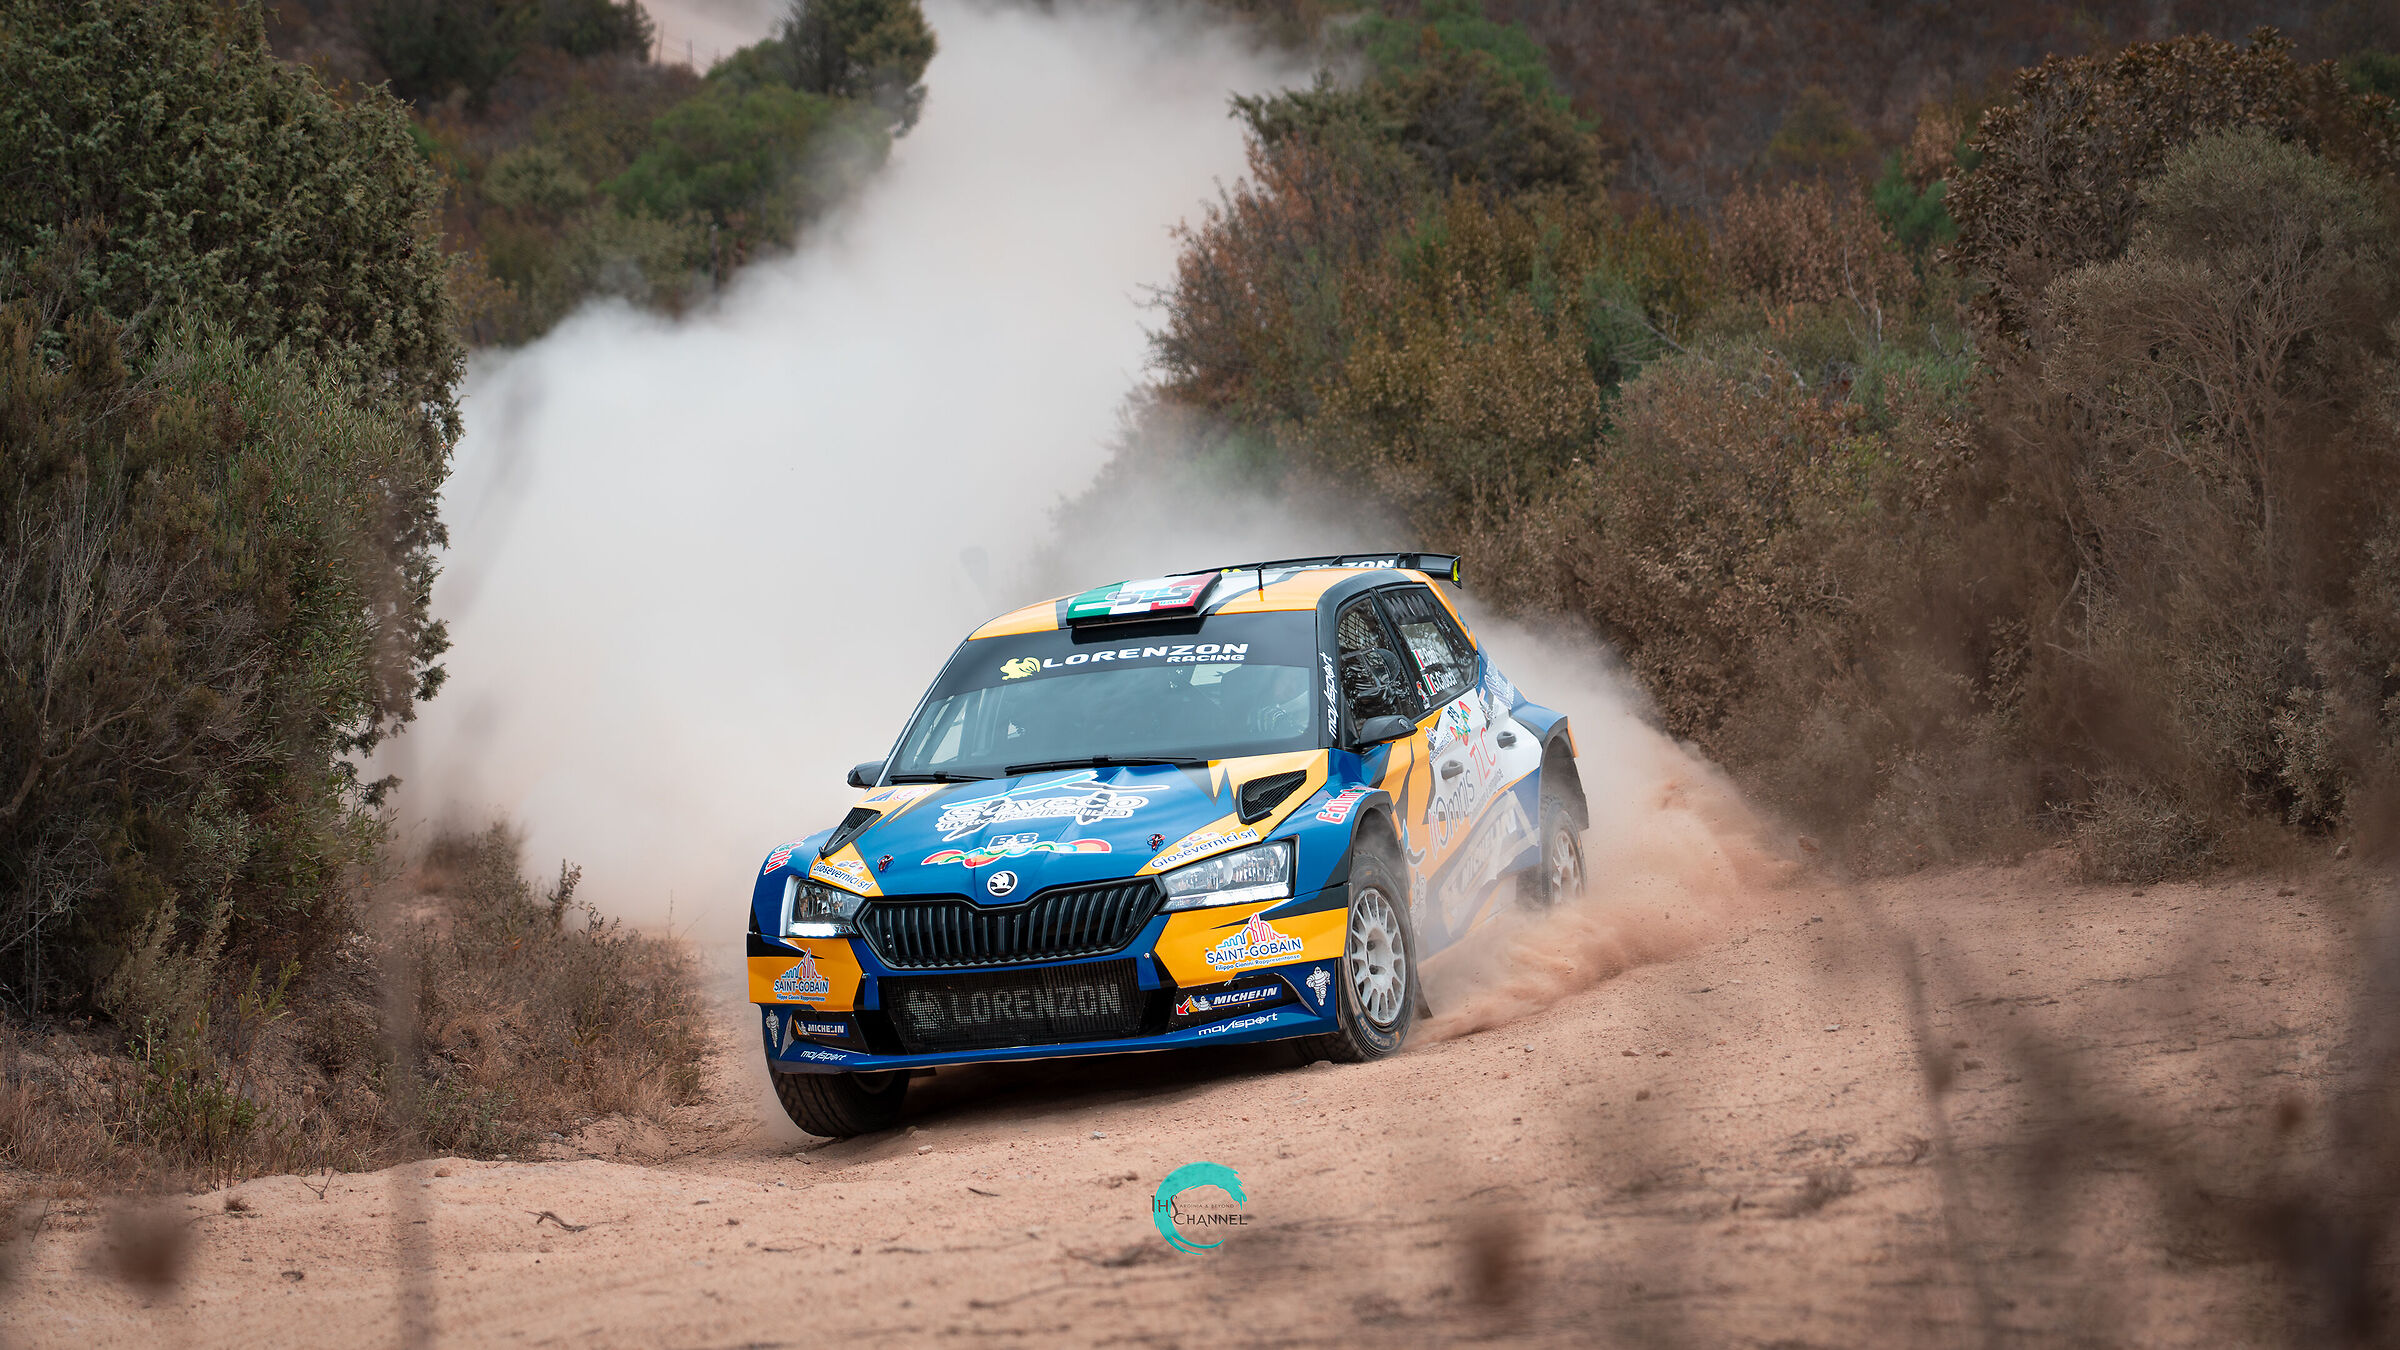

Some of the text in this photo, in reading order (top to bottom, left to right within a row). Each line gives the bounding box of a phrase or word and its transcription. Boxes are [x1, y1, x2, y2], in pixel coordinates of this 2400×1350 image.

[1042, 643, 1249, 669] LORENZON
[1165, 654, 1246, 664] RACING
[1206, 938, 1302, 964] SAINT-GOBAIN
[773, 979, 830, 993] SAINT-GOBAIN
[1212, 986, 1278, 1005] MICHELIN
[950, 983, 1122, 1025] LORENZON
[807, 1023, 845, 1034] MICHELIN
